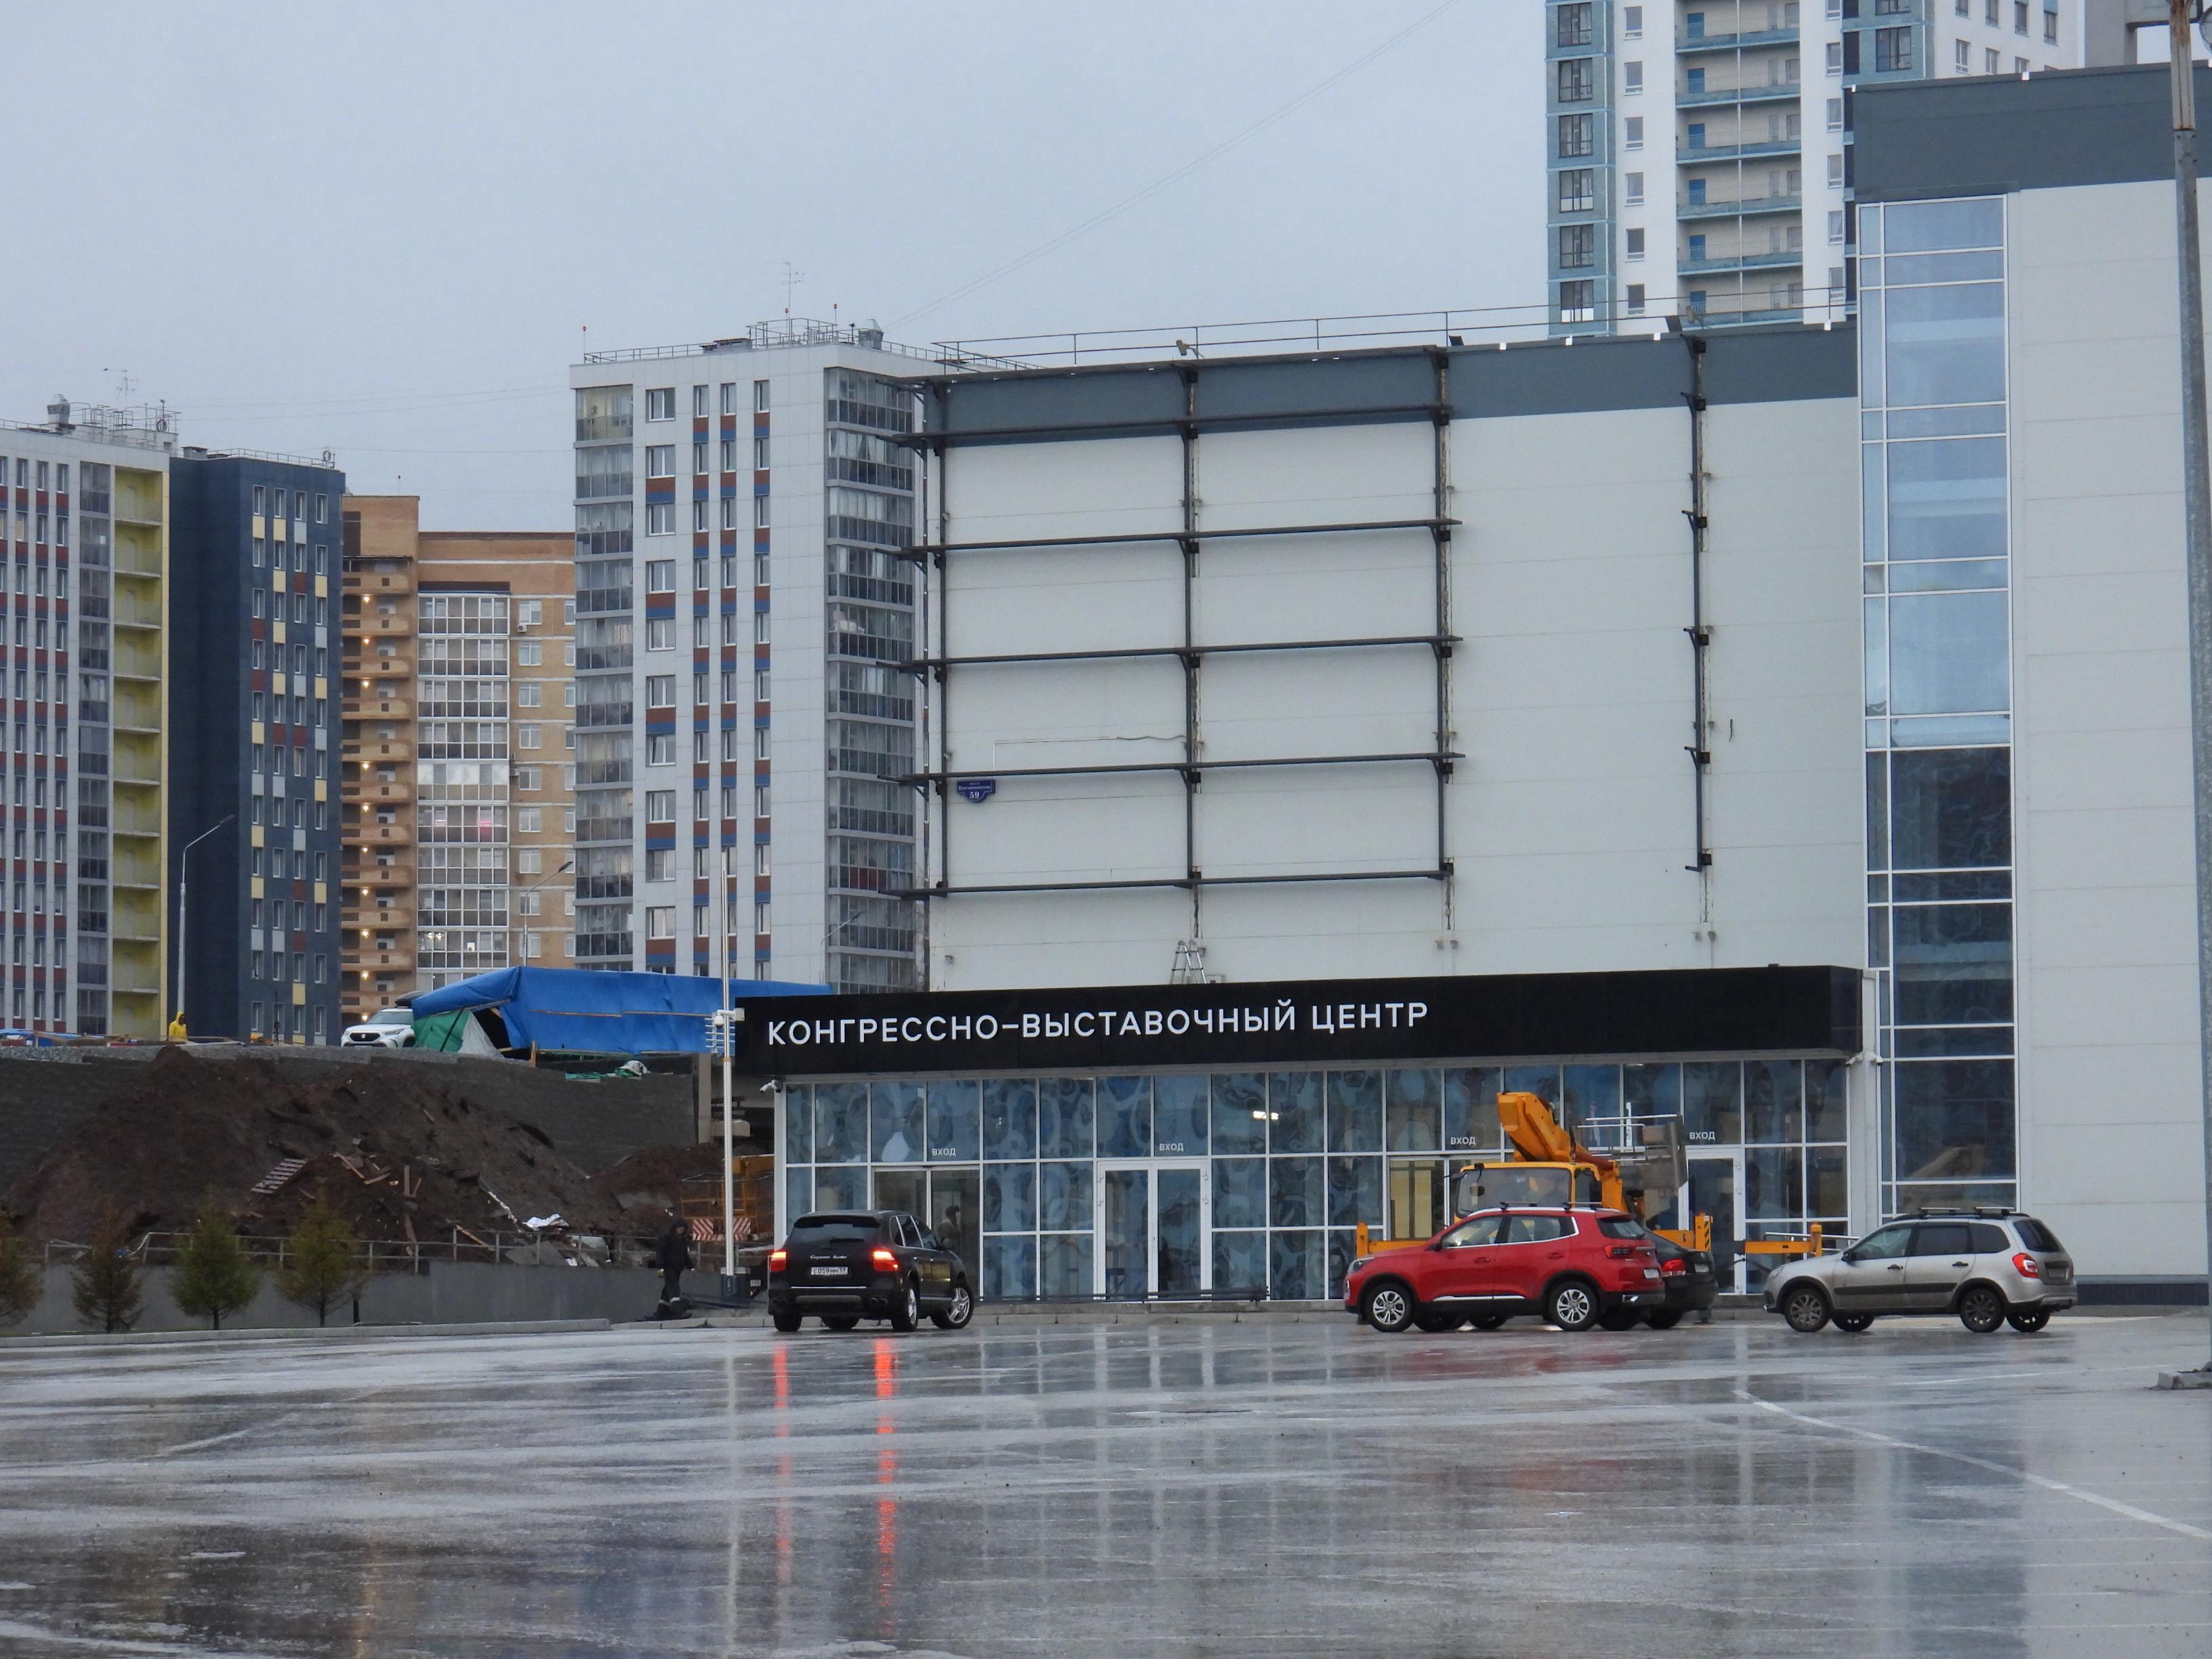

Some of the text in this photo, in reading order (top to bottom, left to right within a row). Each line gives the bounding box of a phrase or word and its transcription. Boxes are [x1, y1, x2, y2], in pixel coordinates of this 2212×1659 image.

[769, 999, 1428, 1045] КОНГРЕССНО-ВЫСТАВОЧНЫЙ ЦЕНТР
[1450, 1136, 1476, 1146] ВХОД
[1689, 1131, 1716, 1141] ВХОД
[932, 1148, 956, 1157] ВХОД
[1159, 1143, 1184, 1152] ВХОД
